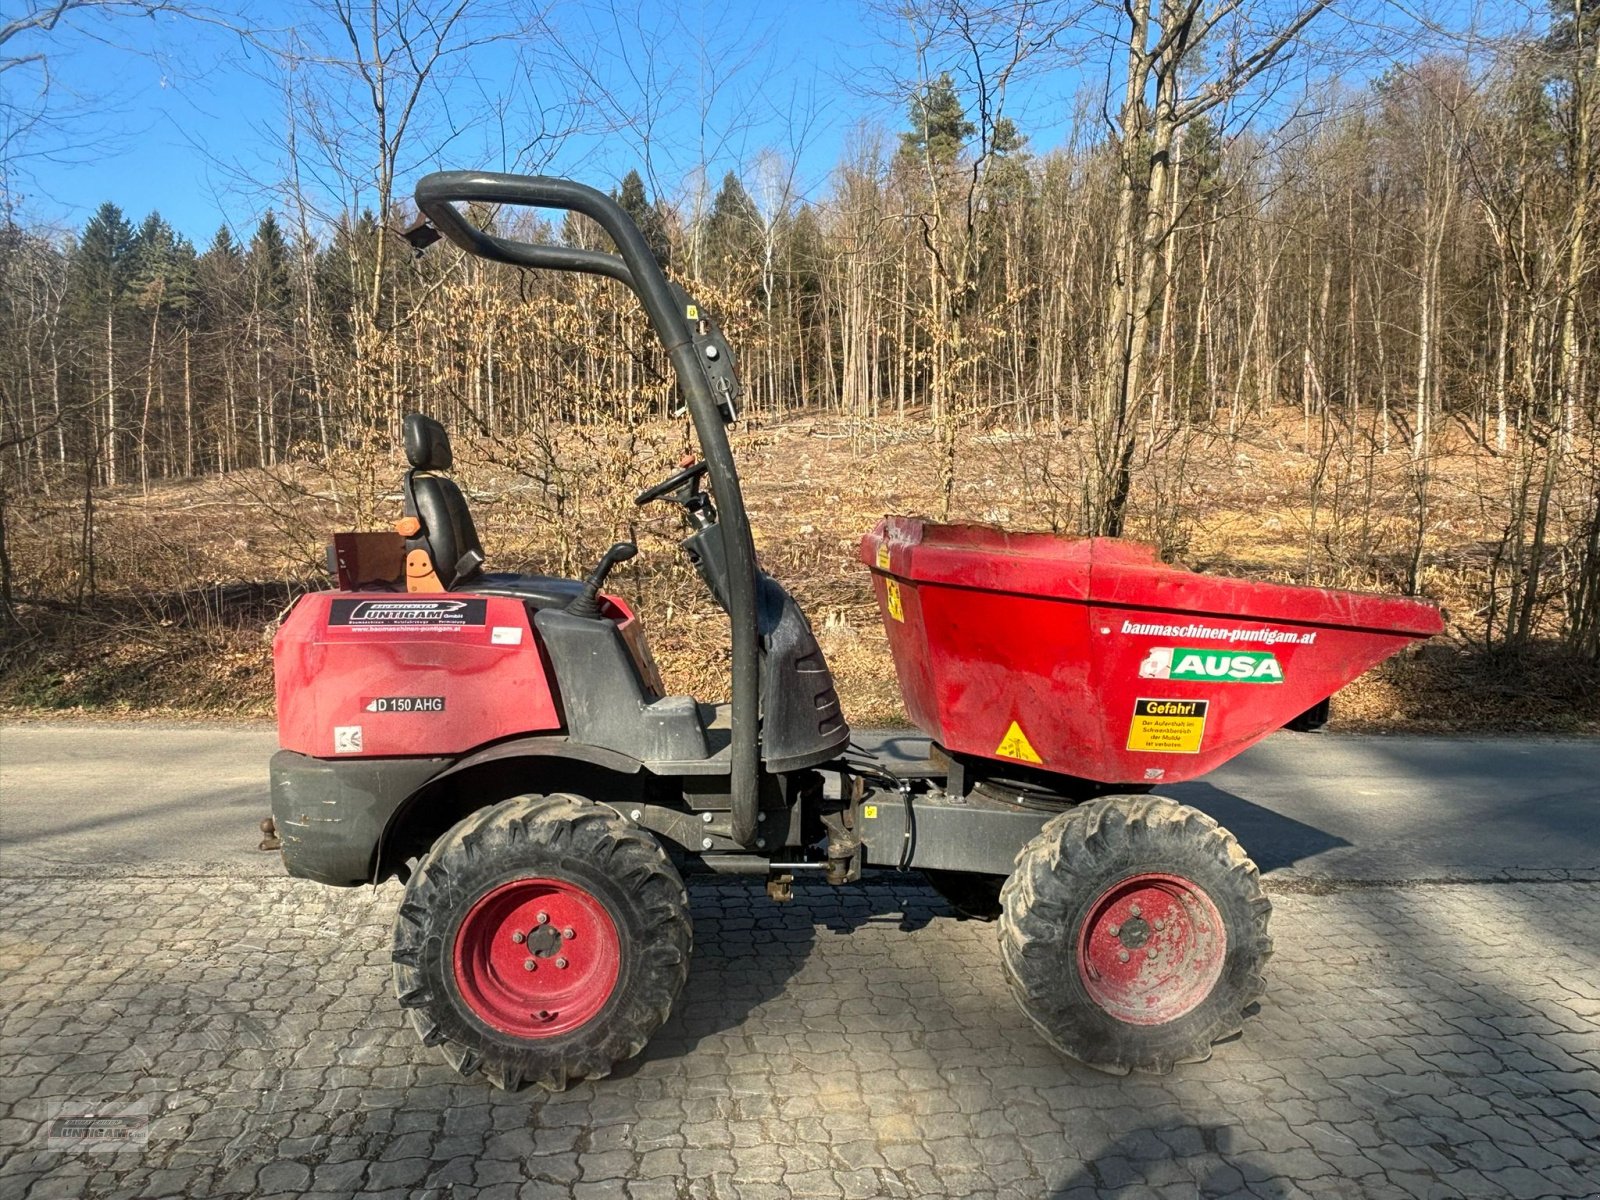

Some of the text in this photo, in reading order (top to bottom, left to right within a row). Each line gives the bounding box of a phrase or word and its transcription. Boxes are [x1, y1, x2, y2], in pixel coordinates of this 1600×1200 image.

[1121, 620, 1316, 645] baumaschinen-puntigam.at
[1172, 655, 1283, 678] AUSA
[378, 698, 442, 711] D 150 AHG
[1146, 701, 1196, 715] Gefahr!
